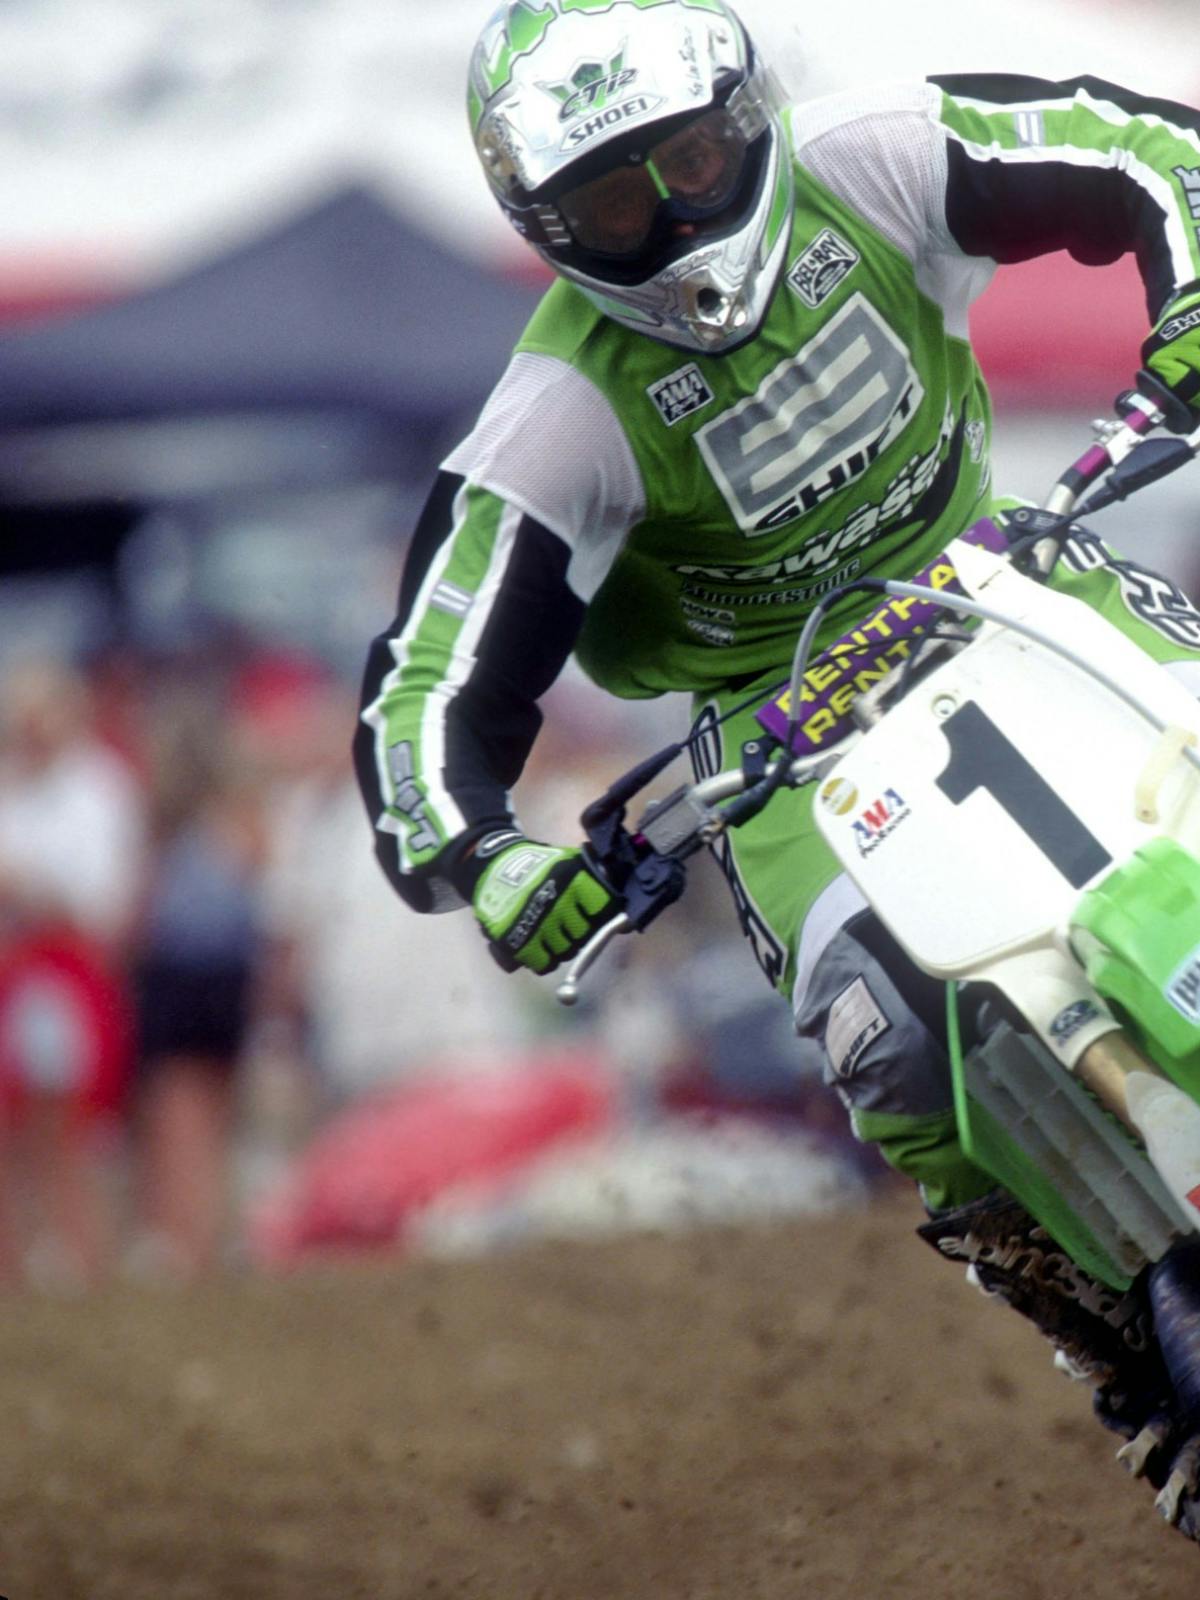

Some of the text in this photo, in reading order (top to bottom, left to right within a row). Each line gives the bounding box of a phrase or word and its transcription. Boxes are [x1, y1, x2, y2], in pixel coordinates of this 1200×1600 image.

[568, 97, 648, 146] SHOEI
[754, 382, 913, 531] SHIFT
[776, 543, 984, 713] RENTHA
[934, 699, 1114, 890] 1
